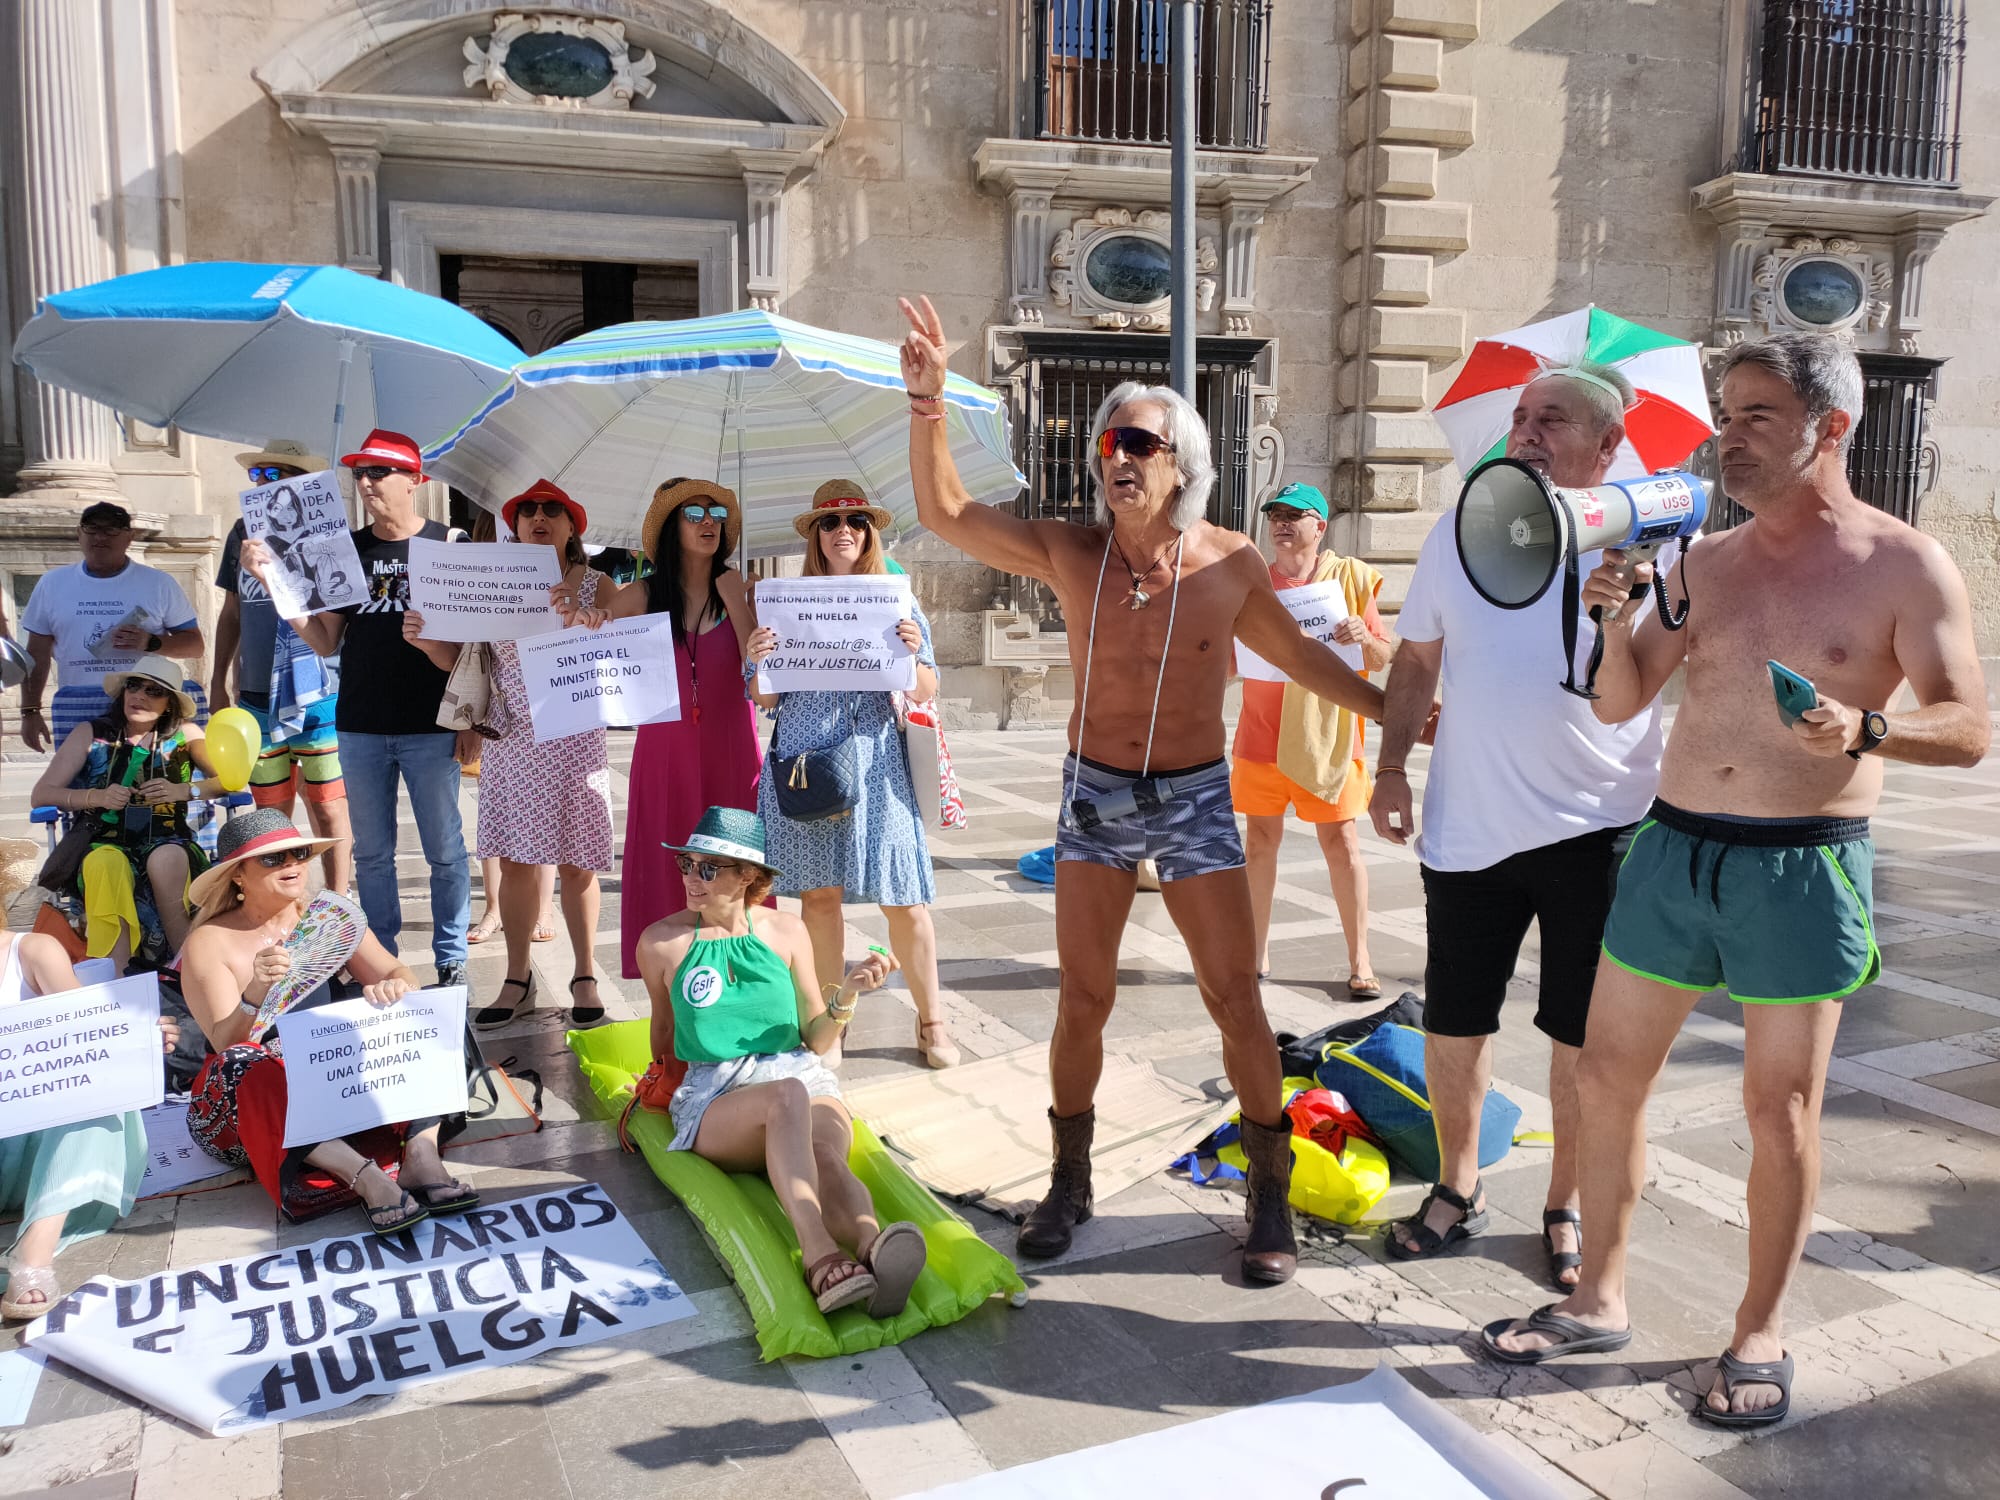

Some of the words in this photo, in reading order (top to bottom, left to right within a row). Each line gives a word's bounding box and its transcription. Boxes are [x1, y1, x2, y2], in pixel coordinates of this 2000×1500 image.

[245, 490, 273, 506] ESTA
[303, 480, 321, 491] ES
[1662, 495, 1690, 509] USO
[247, 509, 263, 520] TU
[303, 492, 335, 507] IDEA
[251, 522, 265, 533] DE
[308, 509, 325, 520] LA
[309, 518, 347, 535] JUSTICIA
[432, 562, 493, 574] FUNCIONARI@S
[494, 565, 505, 573] DE
[506, 565, 538, 573] JUSTICIA
[420, 576, 440, 585] CON
[443, 577, 465, 588] FRÍO
[478, 581, 498, 589] CON
[501, 582, 532, 590] CALOR
[534, 582, 551, 591] LOS
[423, 602, 492, 614] PROTESTAMOS
[517, 606, 549, 614] FUROR
[448, 592, 524, 604] FUNCIONARI@S
[756, 595, 834, 604] FUNCIONARI@S
[837, 596, 850, 604] DE
[853, 595, 899, 604] JUSTICIA
[798, 613, 812, 621] EN
[816, 613, 858, 621] HUELGA
[528, 638, 579, 653] FUNCIONARI@S
[589, 633, 615, 641] JUSTICIA
[625, 626, 650, 636] HUELGA
[784, 638, 805, 649] Sin
[808, 638, 884, 652] nosotr@s...
[556, 655, 577, 668] SIN
[580, 650, 614, 664] TOGA
[617, 647, 631, 659] EL
[762, 657, 784, 670] NO
[787, 657, 817, 670] HAY
[818, 658, 881, 671] JUSTICIA
[550, 667, 619, 688] MINISTERIO
[622, 665, 641, 677] NO
[571, 685, 623, 703] DIALOGA
[693, 976, 716, 994] CSIF
[55, 1013, 71, 1023] DE
[74, 1001, 122, 1020] JUSTICIA
[310, 1015, 380, 1039] FUNCIONARI@S
[382, 1012, 393, 1022] DE
[395, 1008, 434, 1020] JUSTICIA
[22, 1033, 69, 1057] AQUÍ
[72, 1023, 129, 1045] TIENES
[309, 1044, 356, 1065] PEDRO,
[358, 1032, 391, 1053] AQUÍ
[394, 1027, 439, 1045] TIENES
[21, 1048, 110, 1077] CAMPAÑA
[326, 1065, 355, 1082] UNA
[357, 1049, 422, 1073] CAMPAÑA
[0, 1074, 92, 1103] CALENTITA
[341, 1073, 407, 1099] CALENTITA
[46, 1185, 617, 1333] FUNCIONARIOS
[224, 1245, 589, 1356] JUSTICIA
[261, 1290, 623, 1412] HUELGA
